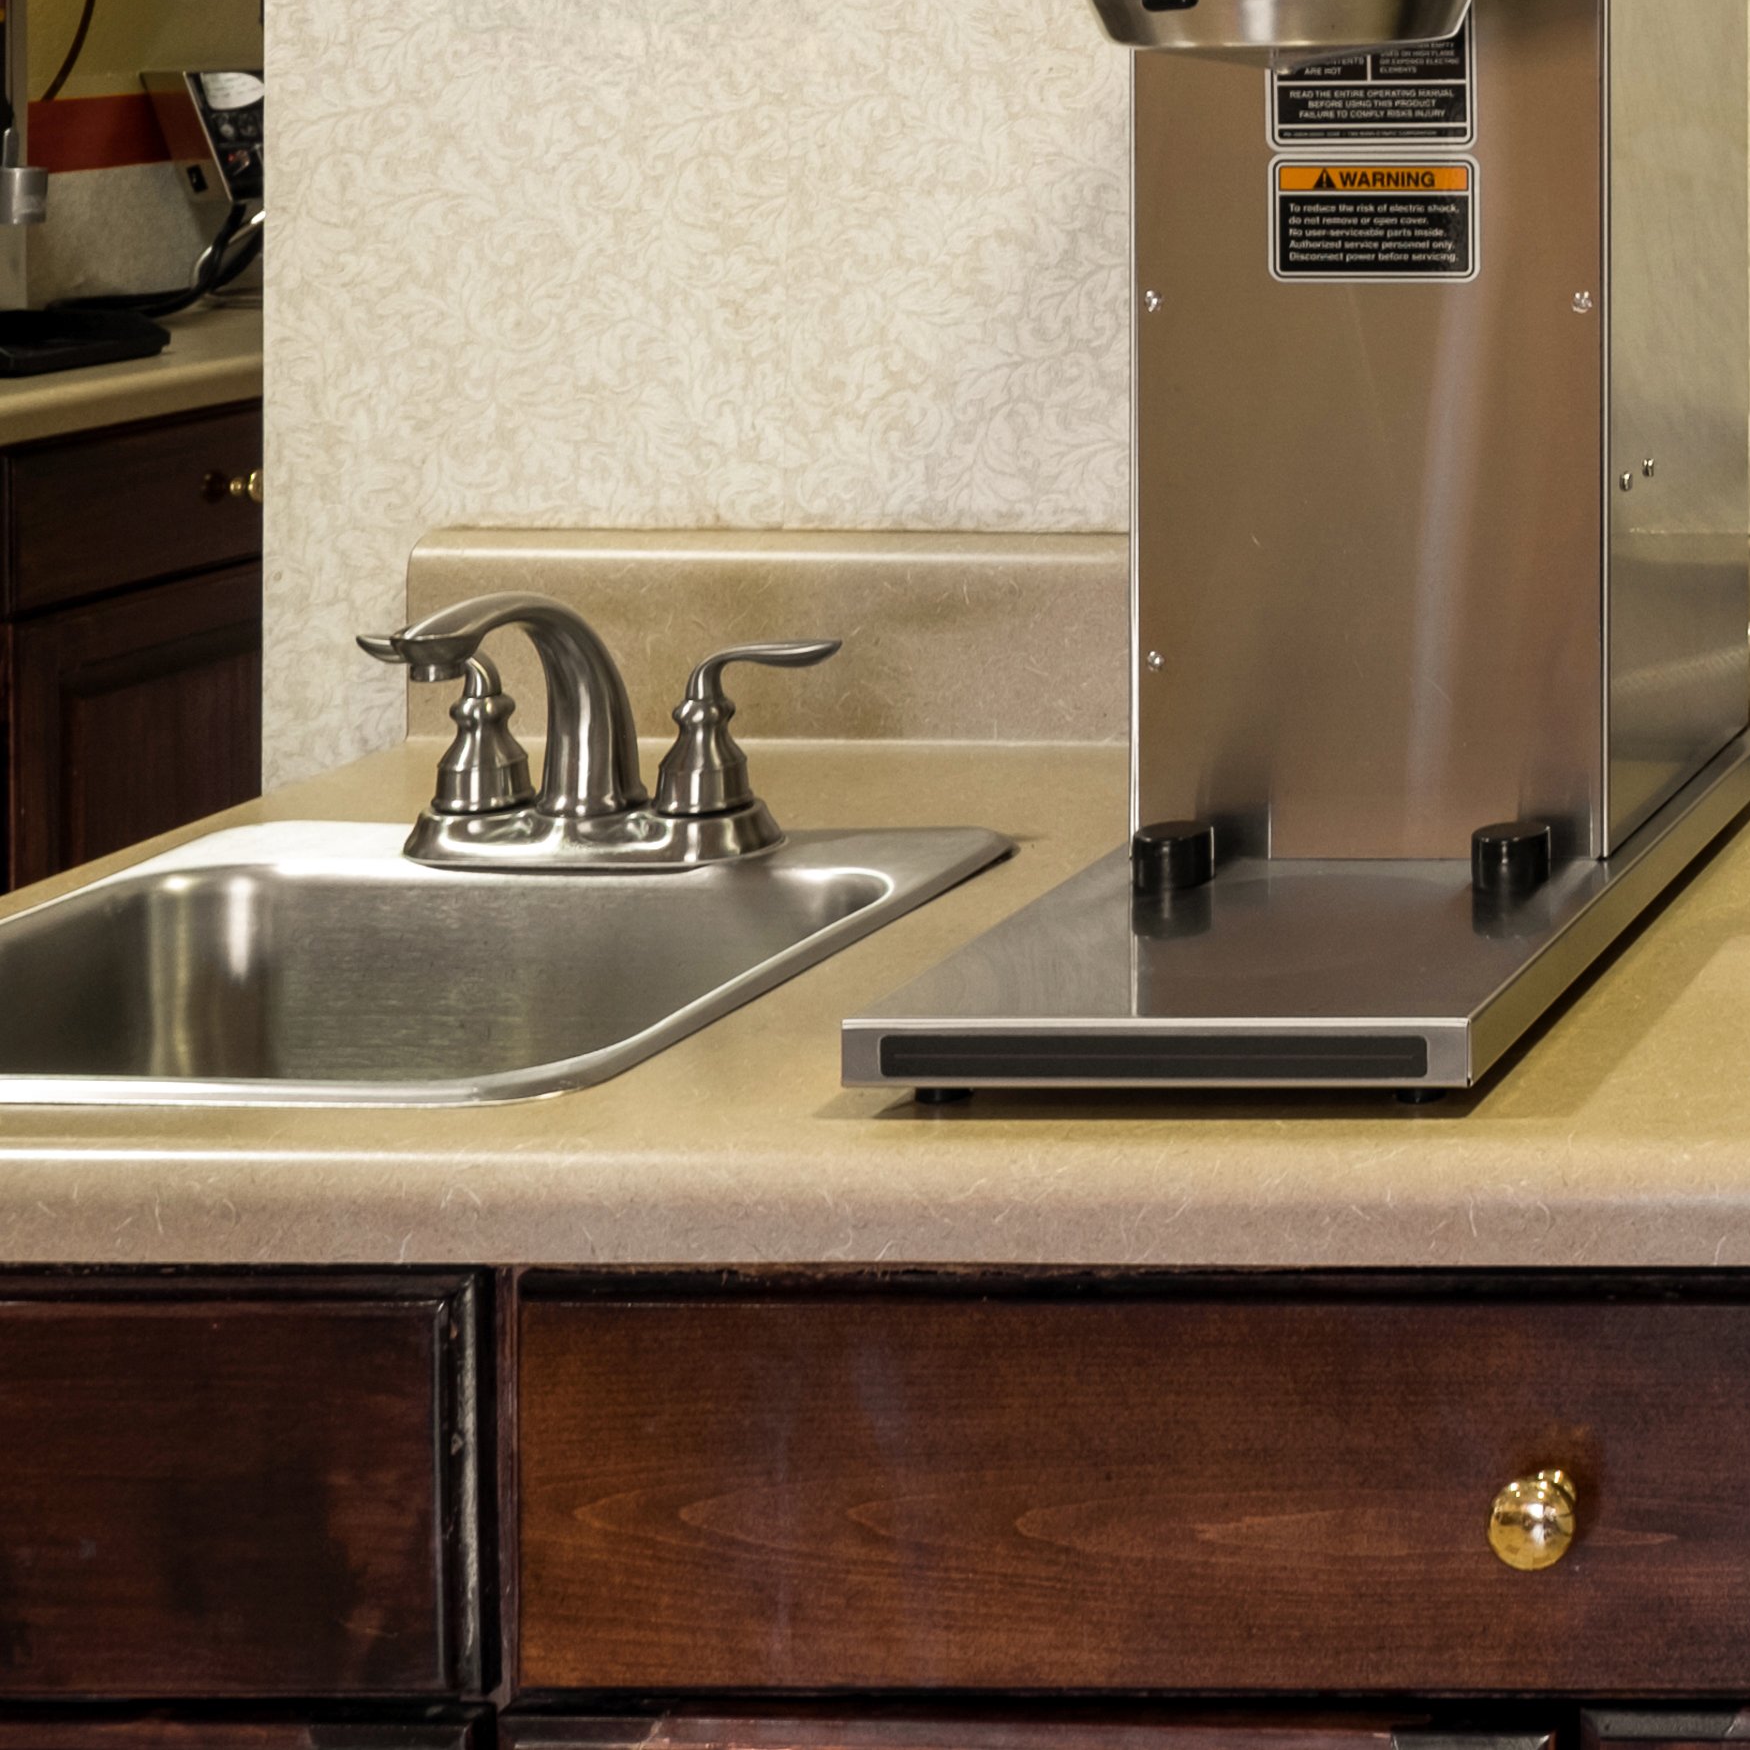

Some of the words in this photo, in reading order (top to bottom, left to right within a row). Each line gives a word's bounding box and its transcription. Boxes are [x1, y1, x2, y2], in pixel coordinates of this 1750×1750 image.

[1304, 68, 1322, 76] ARE
[1290, 90, 1314, 99] READ
[1315, 90, 1332, 98] THE
[1367, 90, 1416, 98] OPERATING
[1336, 110, 1348, 118] TO
[1338, 171, 1436, 188] WARNING
[1289, 203, 1301, 213] To
[1303, 203, 1336, 213] reduce
[1338, 203, 1354, 213] the
[1356, 203, 1375, 213] risk
[1377, 203, 1388, 213] of
[1389, 203, 1425, 213] electric
[1288, 215, 1302, 225] do
[1304, 216, 1320, 225] not
[1322, 216, 1358, 225] remove
[1360, 216, 1370, 225] or
[1373, 217, 1398, 226] open
[1288, 228, 1303, 237] No
[1387, 228, 1412, 238] parts
[1289, 239, 1342, 249] Authorized
[1344, 240, 1379, 249] service
[1381, 239, 1430, 251] personnel
[1289, 251, 1344, 261] Disconnect
[1346, 253, 1375, 263] power
[1378, 251, 1409, 261] before
